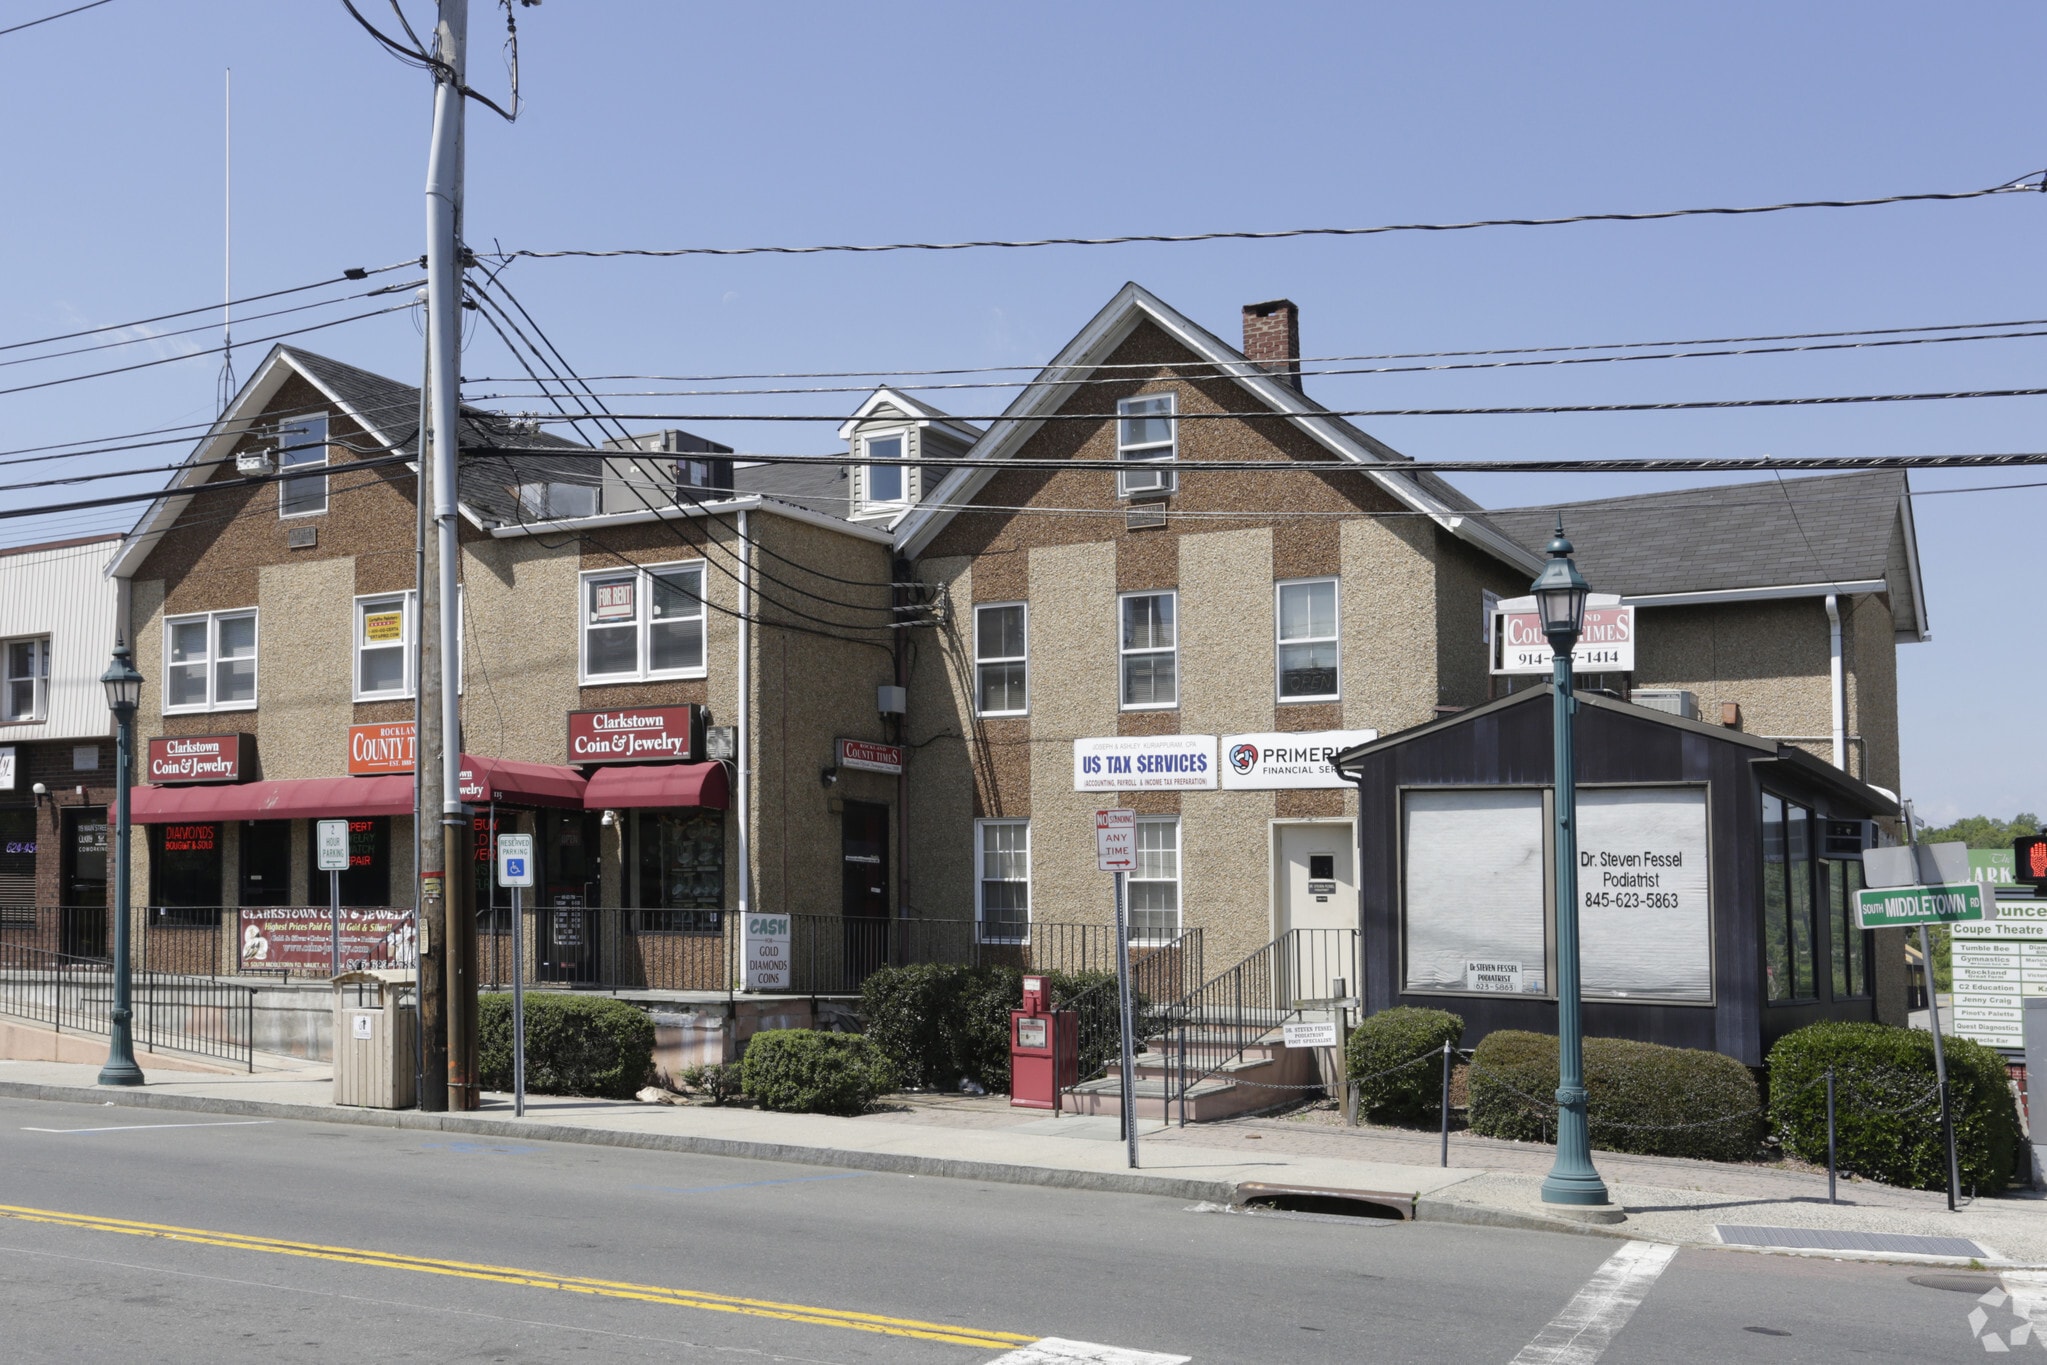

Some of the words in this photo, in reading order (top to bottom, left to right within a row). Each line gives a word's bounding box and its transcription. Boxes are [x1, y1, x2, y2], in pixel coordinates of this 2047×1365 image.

[599, 586, 612, 605] FOR
[612, 586, 631, 605] RENT
[1290, 674, 1332, 690] OPEN
[592, 712, 664, 729] Clarkstown
[380, 727, 415, 736] ROCKLAN
[166, 740, 220, 754] Clarkstown
[352, 732, 404, 761] COUNTY
[574, 736, 610, 753] Coin
[611, 734, 628, 751] &
[626, 732, 683, 756] Jewelry
[846, 742, 874, 760] COUNTY
[876, 750, 898, 764] TIMES
[1263, 747, 1350, 763] PRIMERI
[153, 759, 180, 774] Coin
[180, 758, 192, 774] &
[190, 756, 234, 776] Jewelry
[1106, 756, 1132, 774] TAX
[1262, 766, 1314, 774] FINANCIAL
[460, 782, 484, 798] welry
[494, 791, 502, 800] 115
[1097, 814, 1108, 826] NO
[1110, 816, 1132, 824] STANDING
[94, 824, 107, 832] STREE
[348, 822, 374, 832] PERT
[166, 826, 214, 840] DIAMONDS
[165, 841, 191, 850] BOUGHT
[197, 840, 214, 850] SOLD
[326, 837, 340, 847] HOUR
[322, 849, 344, 858] PARKING
[1106, 847, 1128, 855] TIME
[1580, 851, 1598, 867] Dr.
[1600, 851, 1641, 867] Steven
[1644, 851, 1682, 867] Fessel
[1603, 872, 1660, 888] Podiatrist
[1585, 892, 1679, 908] 845-623-5863
[1862, 903, 1884, 915] SOUTH
[1884, 893, 1966, 918] MIDDLETOWN
[1970, 897, 1980, 908] RD
[242, 908, 318, 919] CLARKSTOWN
[320, 908, 347, 919] CON
[351, 909, 359, 919] &
[264, 922, 288, 932] Highest
[289, 922, 308, 930] Prices
[309, 922, 323, 930] Paid
[323, 922, 332, 930] Fo
[346, 922, 360, 931] Gold
[750, 918, 788, 935] CASH
[1954, 924, 1992, 935] Coupe
[1995, 924, 2044, 935] Theatre
[760, 946, 778, 956] GOLD
[750, 960, 787, 970] DIAMONDS
[1476, 963, 1495, 972] STEVEN
[758, 973, 779, 983] COINS
[1478, 974, 1511, 982] PODIATRIST
[1989, 997, 2012, 1005] Craig
